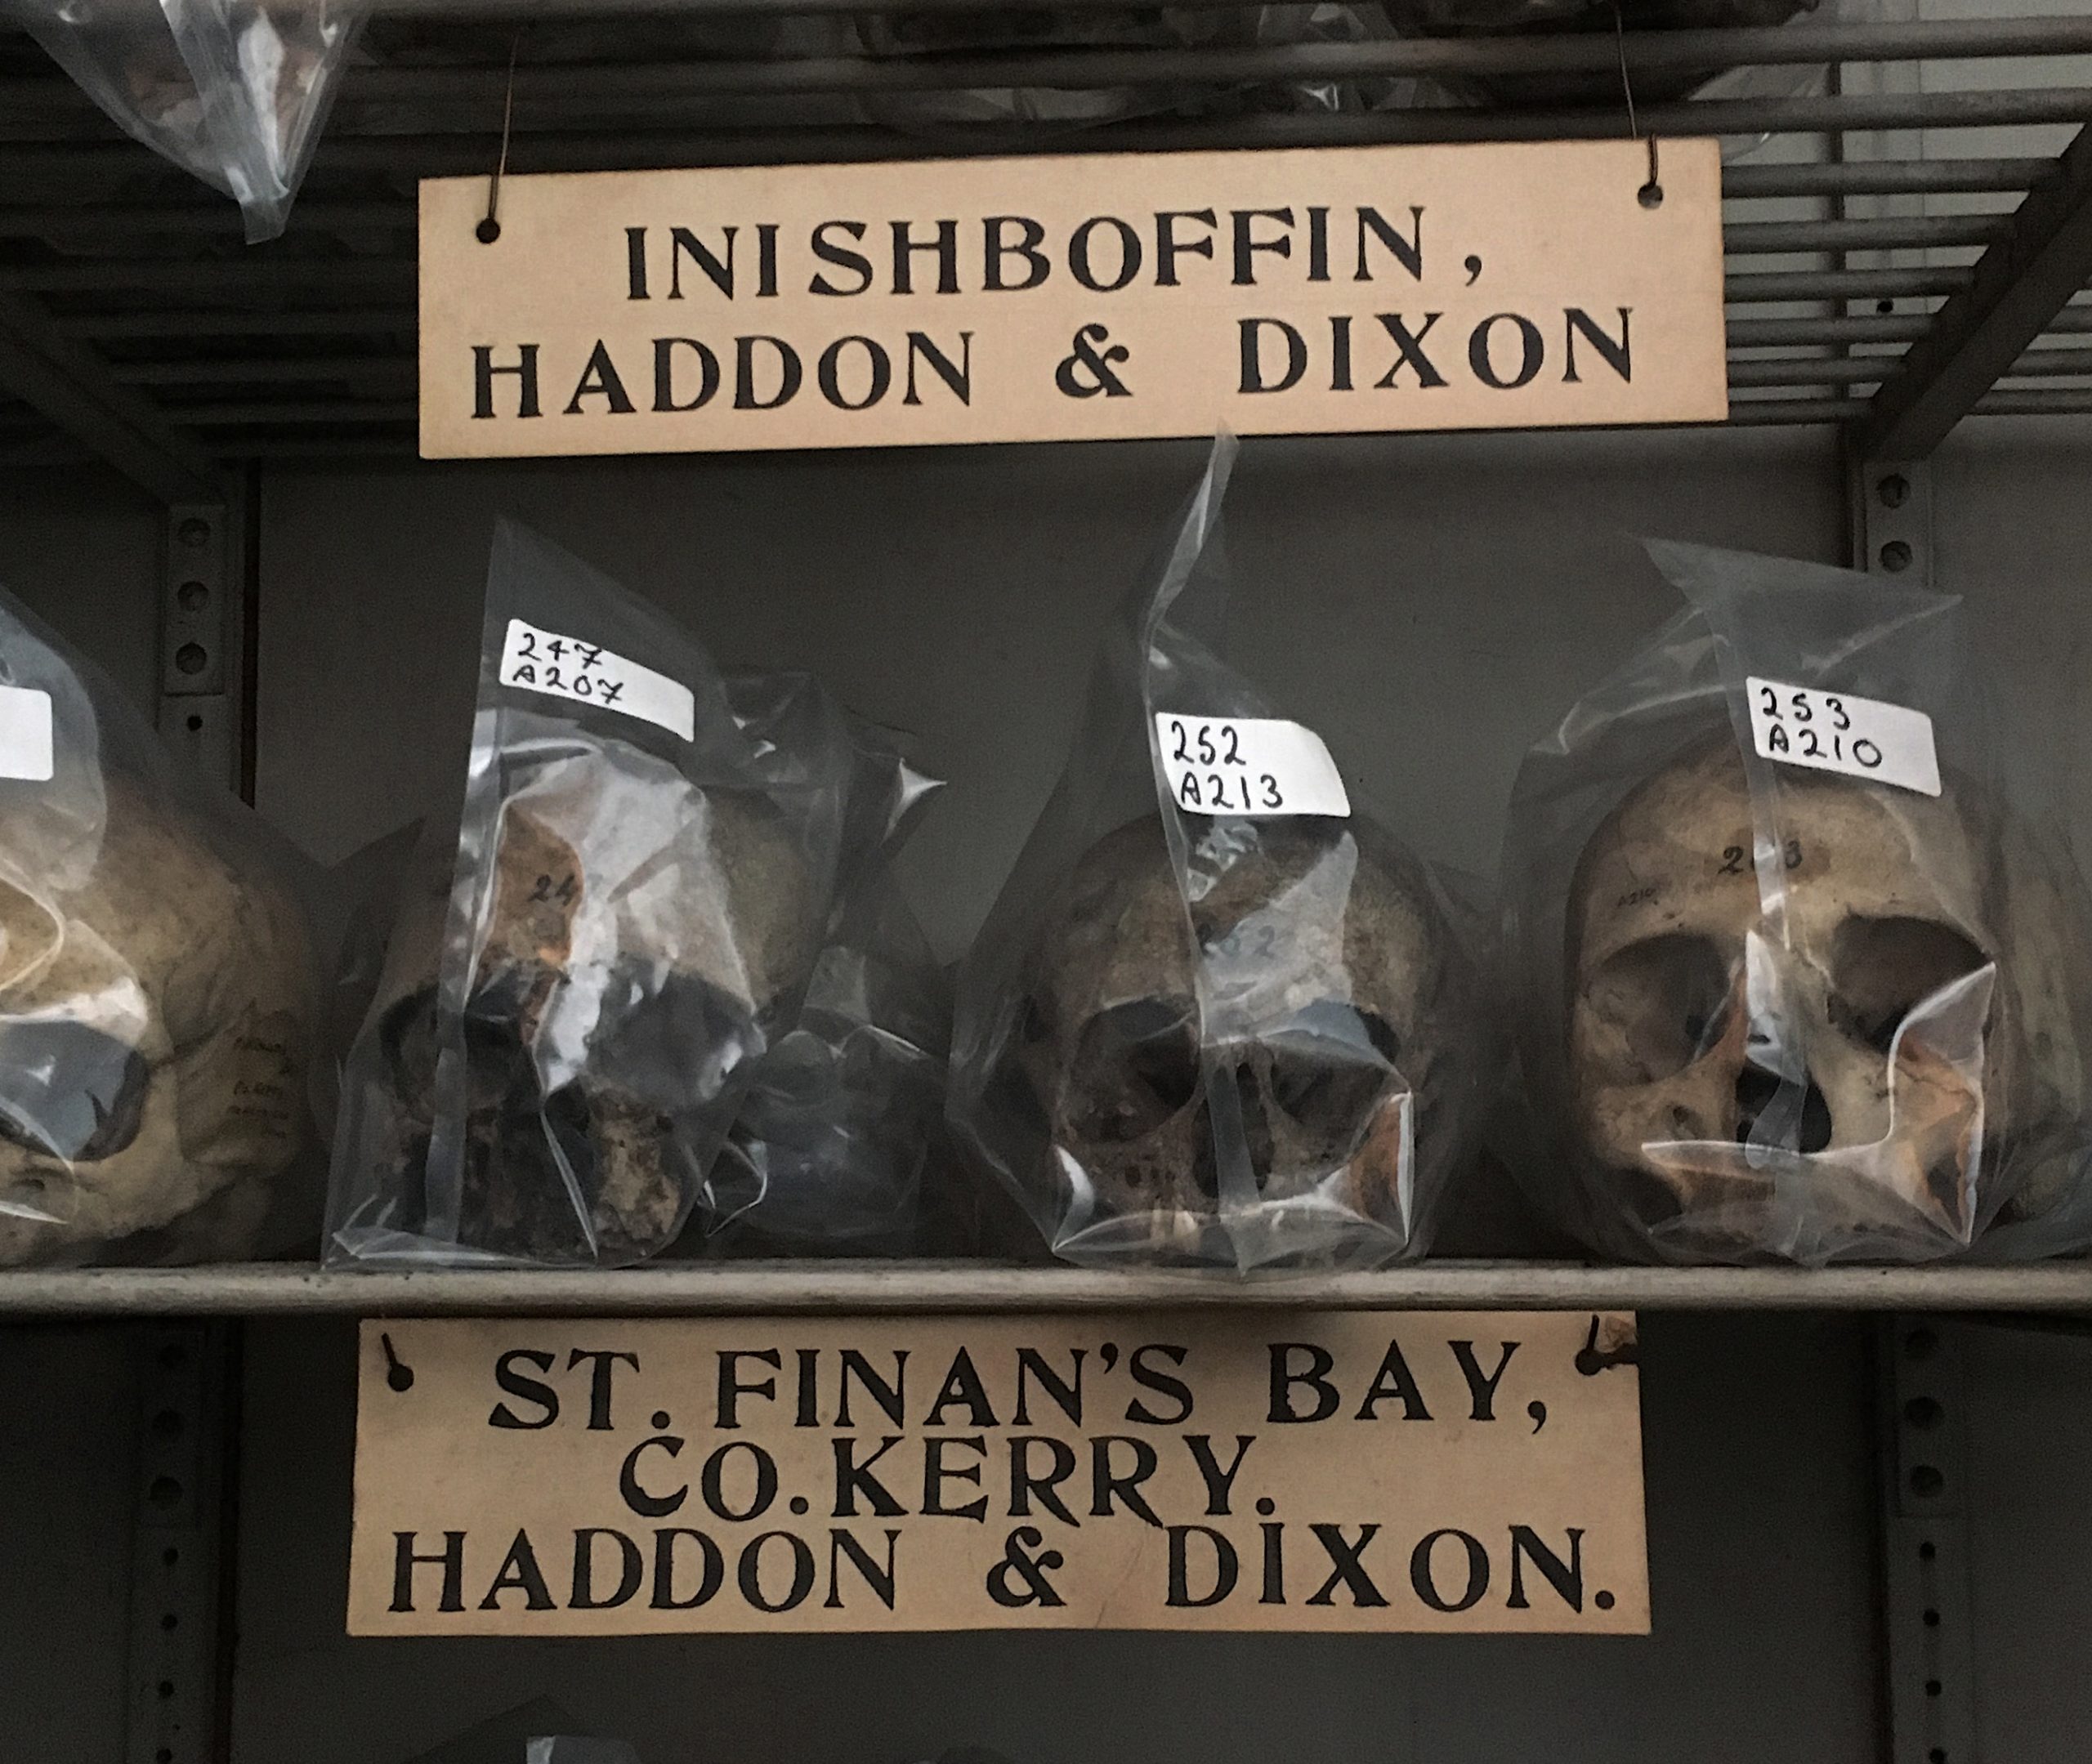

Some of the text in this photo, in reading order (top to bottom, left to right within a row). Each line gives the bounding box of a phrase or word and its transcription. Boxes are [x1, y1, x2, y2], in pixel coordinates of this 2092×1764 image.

[624, 207, 1482, 301] INISHBOFFIN,
[471, 307, 1632, 419] HADDON & DIXON
[517, 632, 602, 670] 247
[512, 664, 624, 704] A207
[1760, 686, 1850, 731] 253
[1171, 721, 1247, 766] 252
[1768, 723, 1883, 768] A210
[1181, 771, 1284, 811] A213
[1717, 840, 1803, 874] 23
[488, 1339, 1546, 1434] ST. FINAN'S BAY,
[387, 1522, 1615, 1614] HADDON & DIXON.
